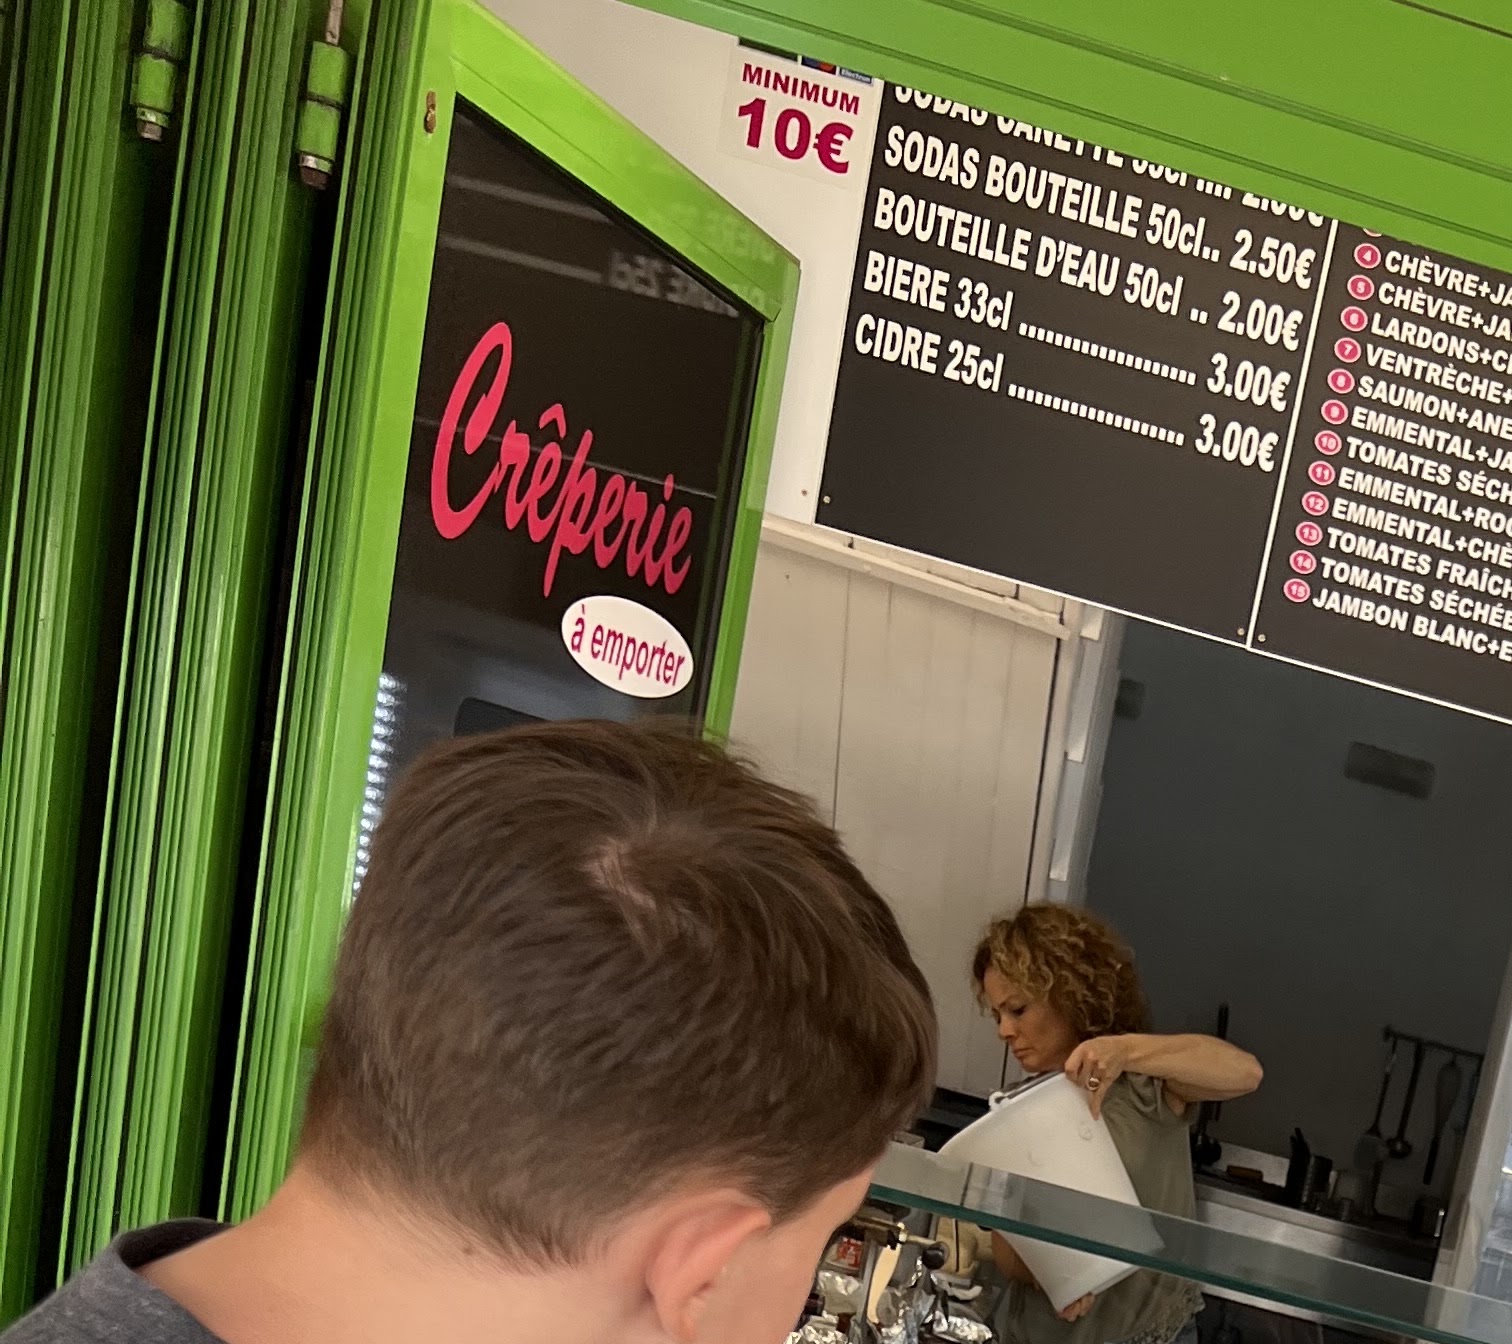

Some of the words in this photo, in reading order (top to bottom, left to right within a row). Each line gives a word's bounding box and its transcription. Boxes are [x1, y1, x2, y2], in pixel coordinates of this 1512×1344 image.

[742, 63, 860, 115] MINIMUM
[738, 97, 854, 174] 10€
[884, 125, 980, 189] SODAS
[984, 154, 1143, 238] BOUTEILLE
[1229, 228, 1316, 290] 2.50€
[873, 187, 1032, 271] BOUTEILLE
[1123, 261, 1184, 316] 50cl
[1216, 290, 1303, 351] 2.00€
[863, 250, 950, 312] BIERE
[953, 277, 1014, 331] 33cl
[1206, 351, 1291, 412] 3.00€
[854, 313, 941, 374] CIDRE
[943, 339, 1004, 392] 25cl
[1194, 413, 1279, 472] 3.00€
[431, 322, 692, 598] Crêperie
[1346, 435, 1452, 486] TOMATES
[1320, 556, 1425, 605] TOMATES
[1326, 526, 1432, 575] TOMATES
[571, 604, 586, 653] à
[590, 631, 686, 687] emporter
[1311, 587, 1409, 631] JAMBON
